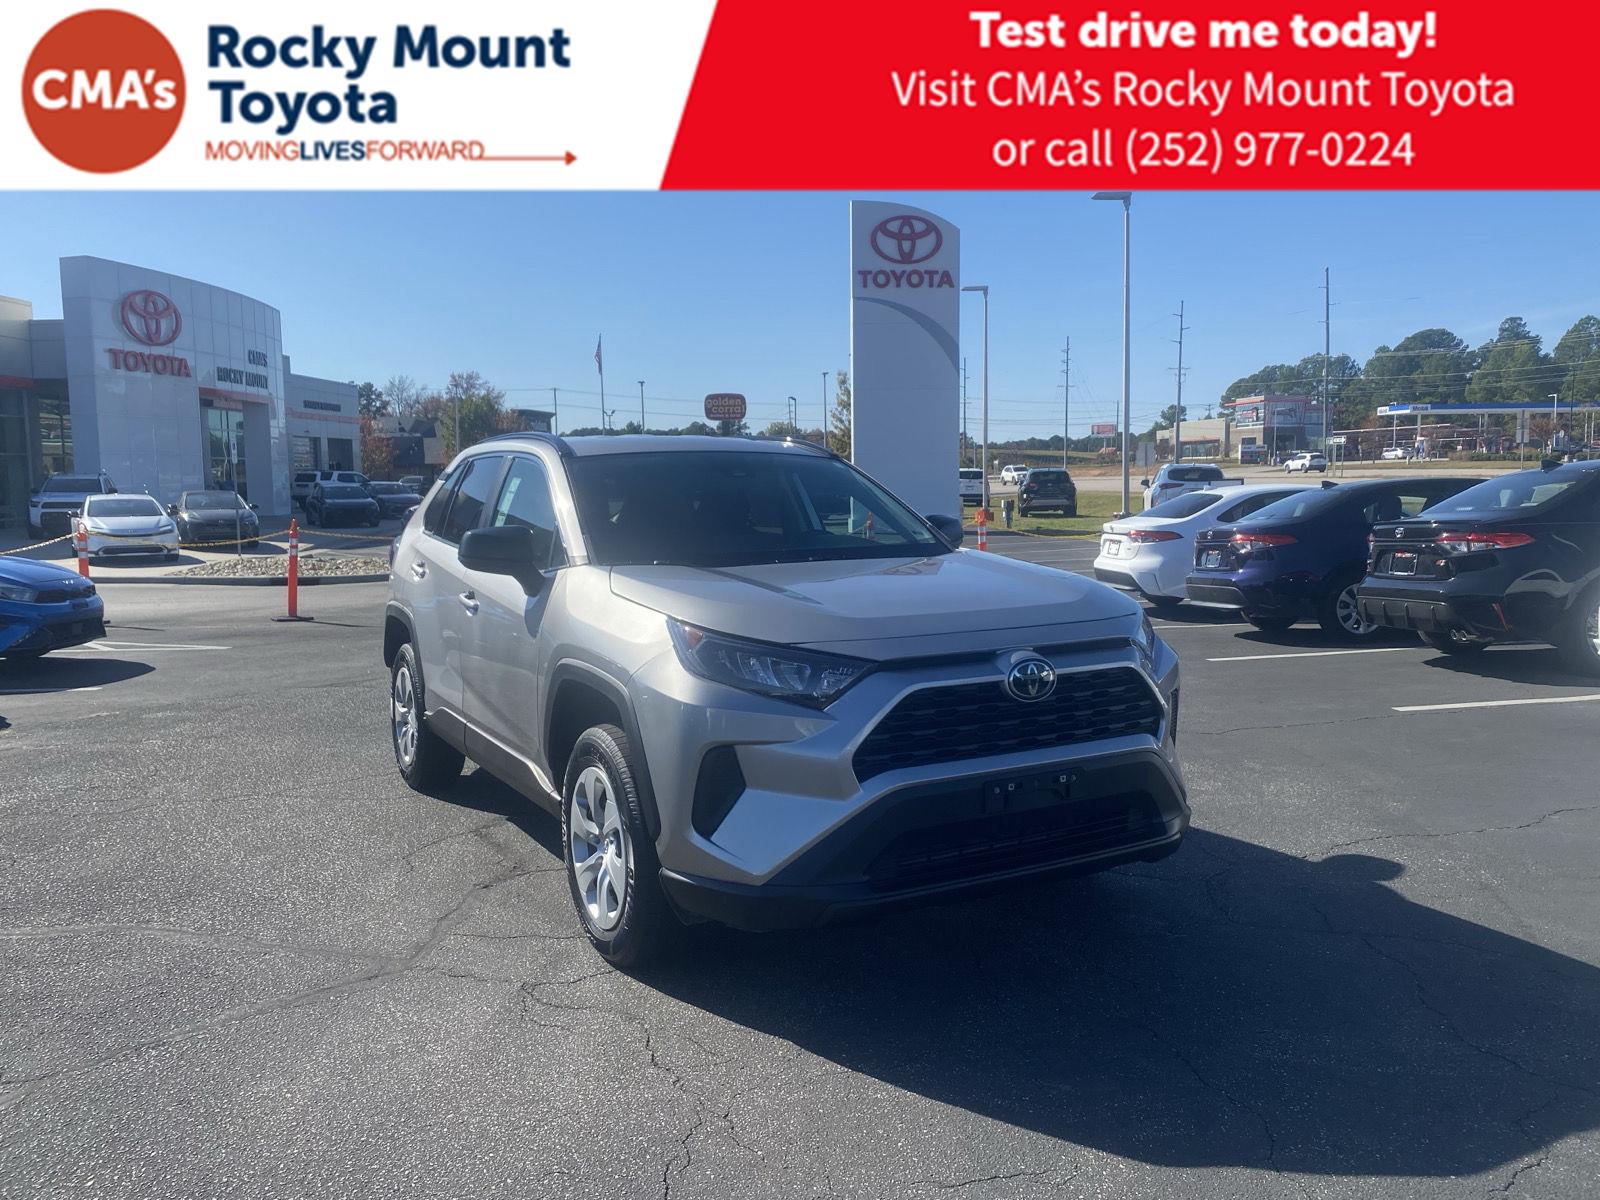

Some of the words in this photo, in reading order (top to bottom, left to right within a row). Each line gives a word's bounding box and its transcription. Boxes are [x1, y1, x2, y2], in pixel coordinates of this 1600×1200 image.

[857, 269, 955, 289] TOYOTA
[107, 347, 192, 378] TOYOTA
[216, 366, 244, 385] ROCKY
[706, 397, 742, 408] golden
[712, 404, 745, 413] corral
